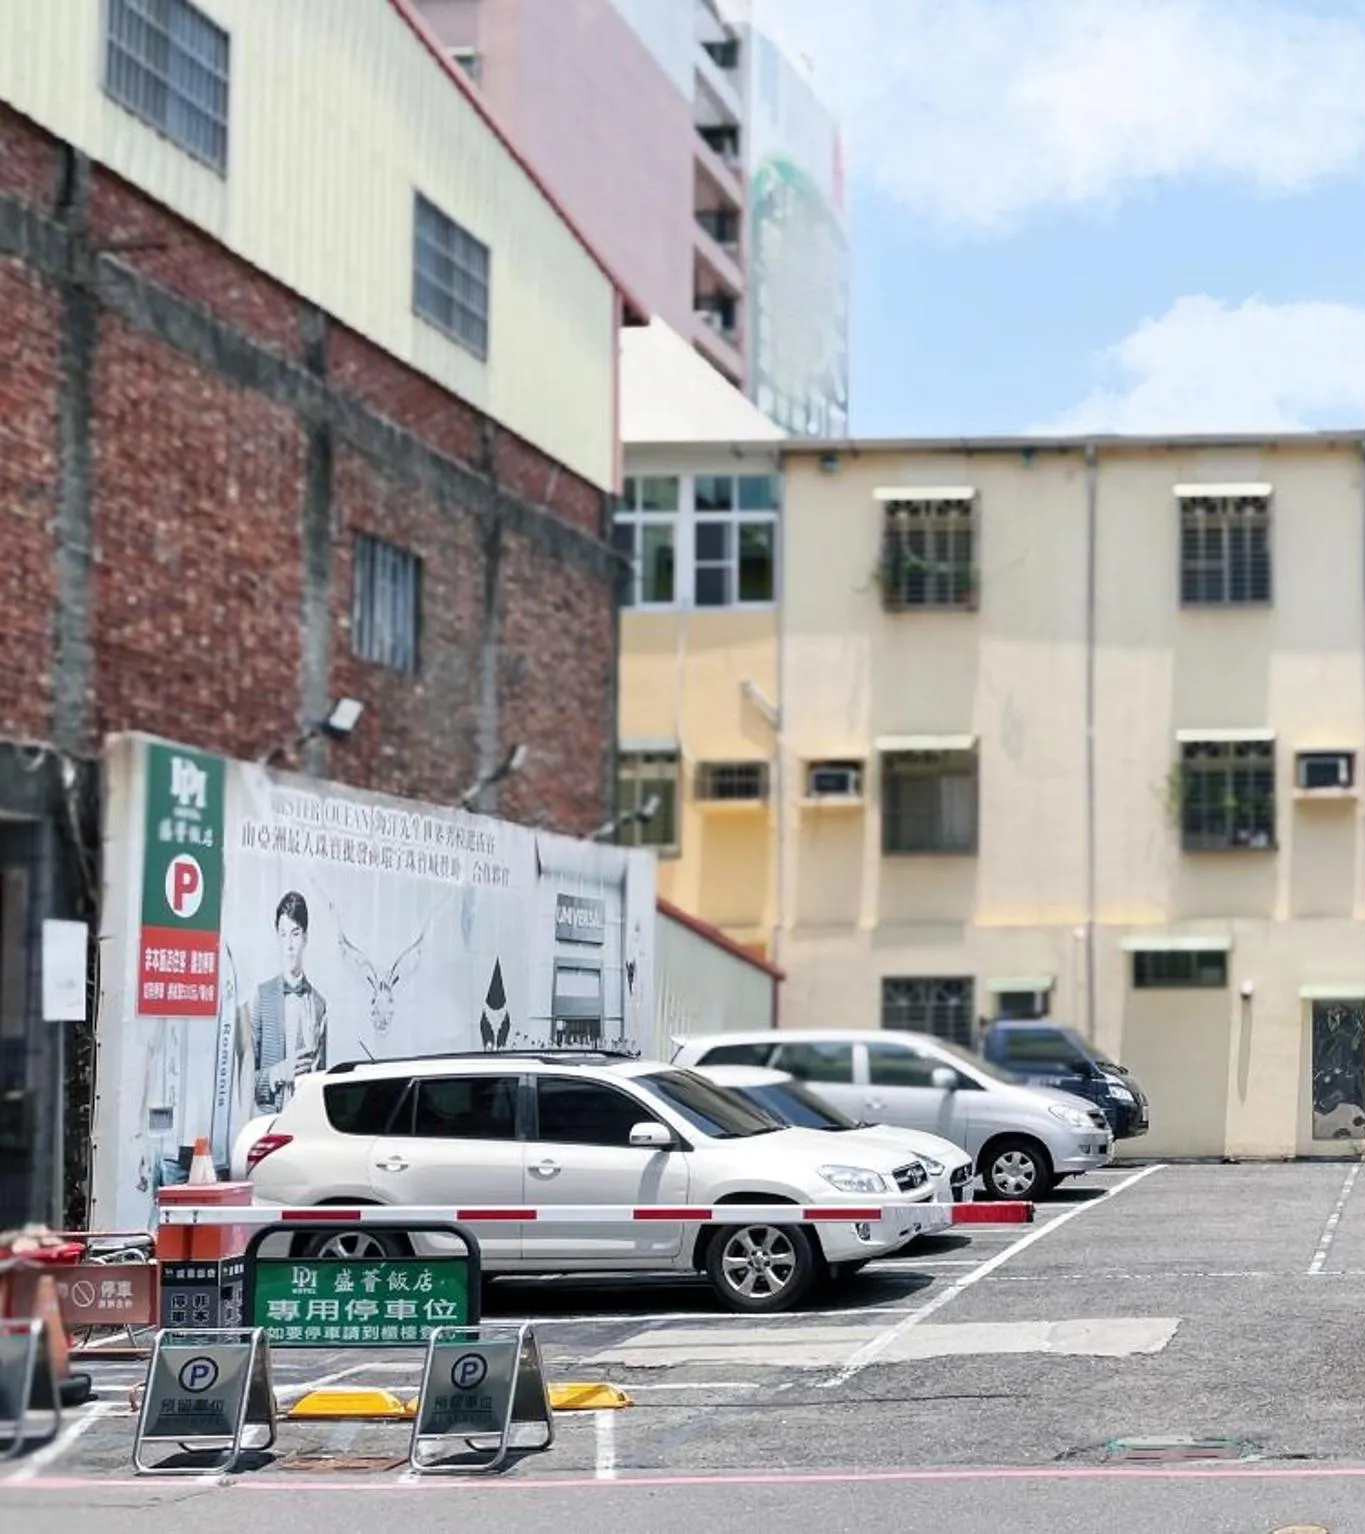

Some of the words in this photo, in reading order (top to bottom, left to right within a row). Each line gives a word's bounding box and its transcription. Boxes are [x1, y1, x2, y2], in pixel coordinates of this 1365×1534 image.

[173, 862, 199, 912] P
[267, 1298, 458, 1322] 專用停車位
[189, 1364, 210, 1387] P
